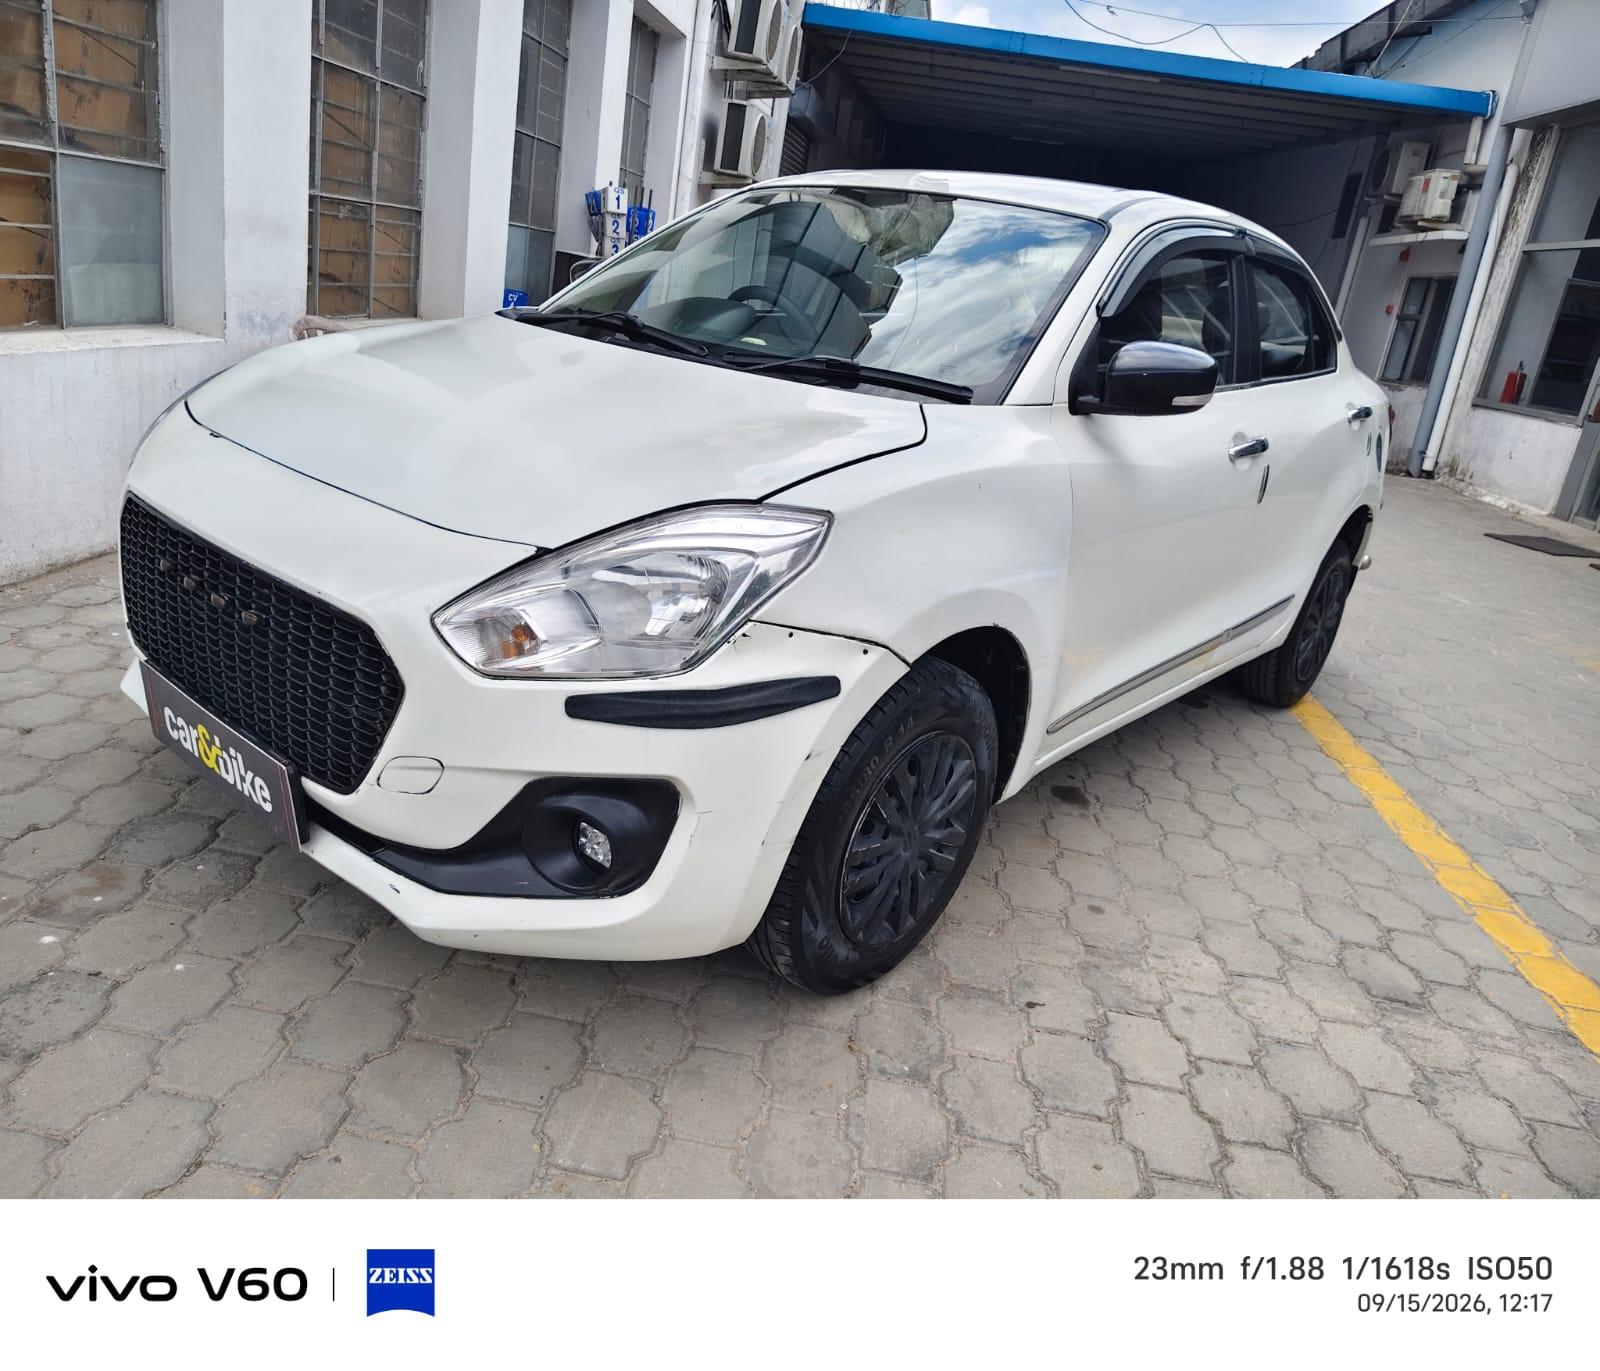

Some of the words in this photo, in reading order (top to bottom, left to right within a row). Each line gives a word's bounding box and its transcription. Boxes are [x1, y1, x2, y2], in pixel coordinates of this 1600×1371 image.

[615, 194, 620, 210] 1
[612, 219, 620, 236] 2
[611, 243, 620, 256] 3
[508, 293, 519, 302] CV
[163, 706, 273, 813] car&bike
